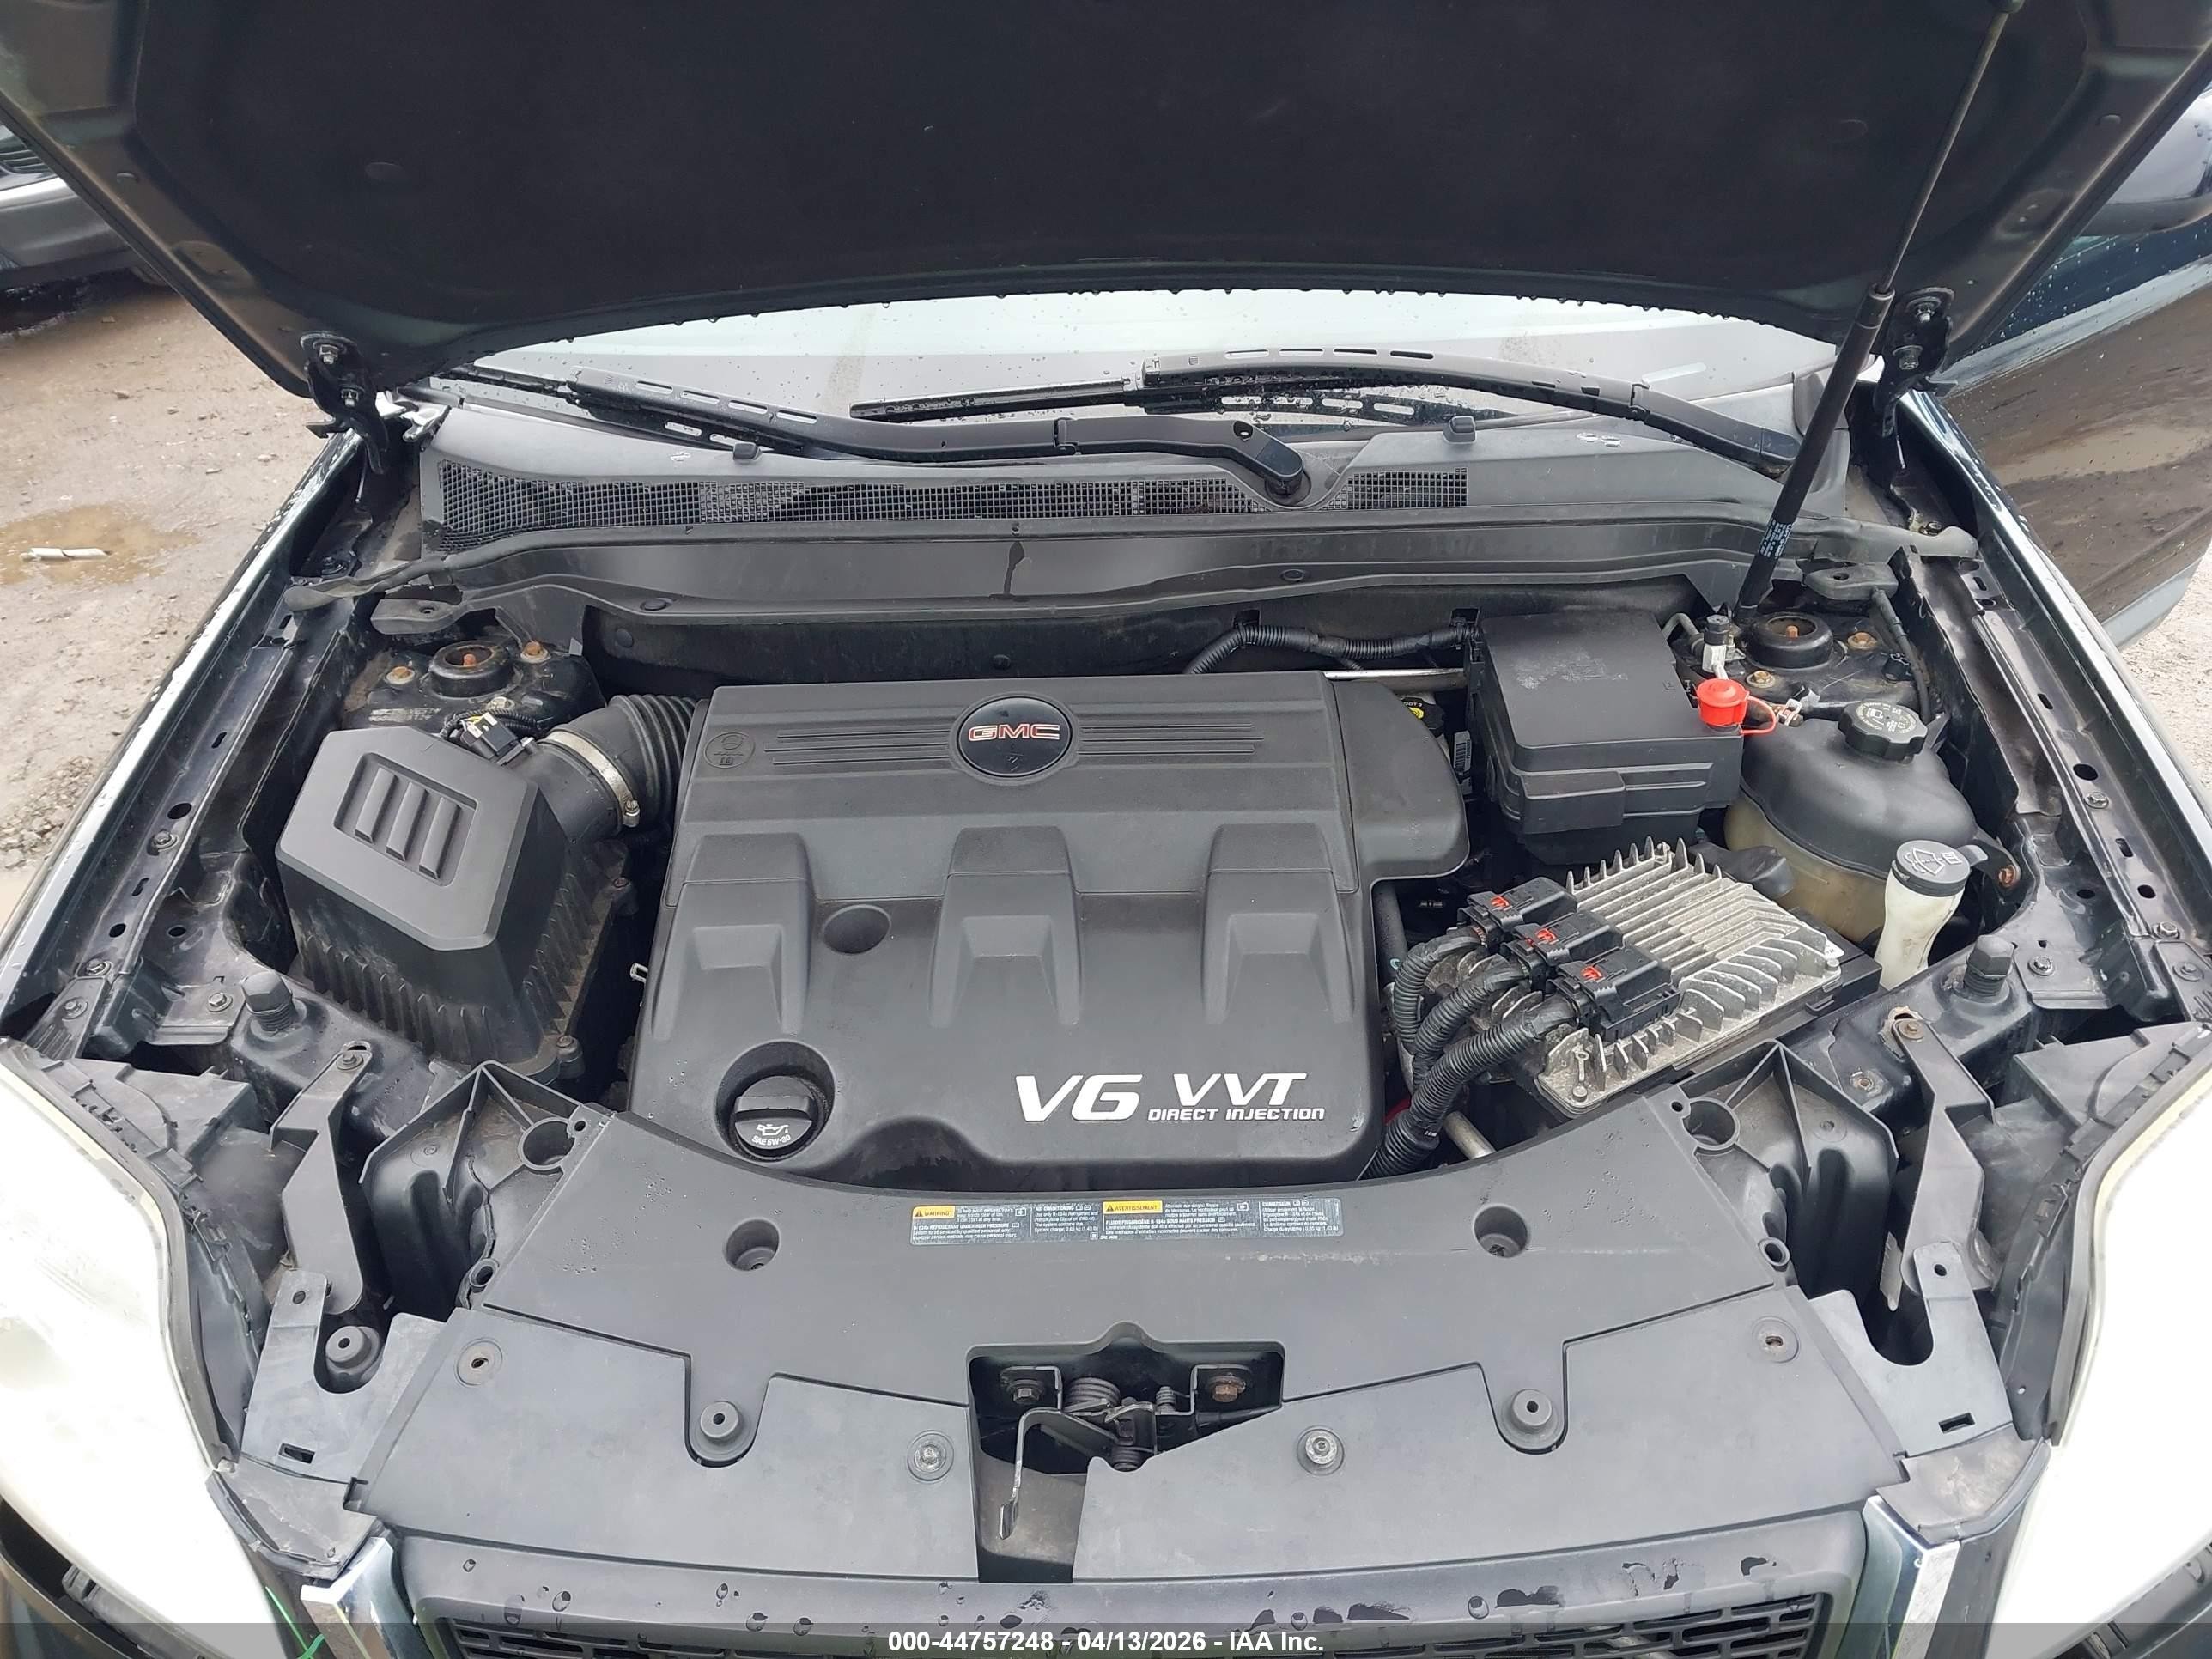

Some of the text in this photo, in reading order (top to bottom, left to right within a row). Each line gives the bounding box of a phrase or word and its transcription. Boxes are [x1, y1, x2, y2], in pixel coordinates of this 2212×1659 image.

[969, 724, 1060, 742] GMC
[1016, 1073, 1307, 1121] V6 VVT
[1148, 1108, 1325, 1121] DIRECT INJECTION
[751, 1135, 766, 1146] SAE
